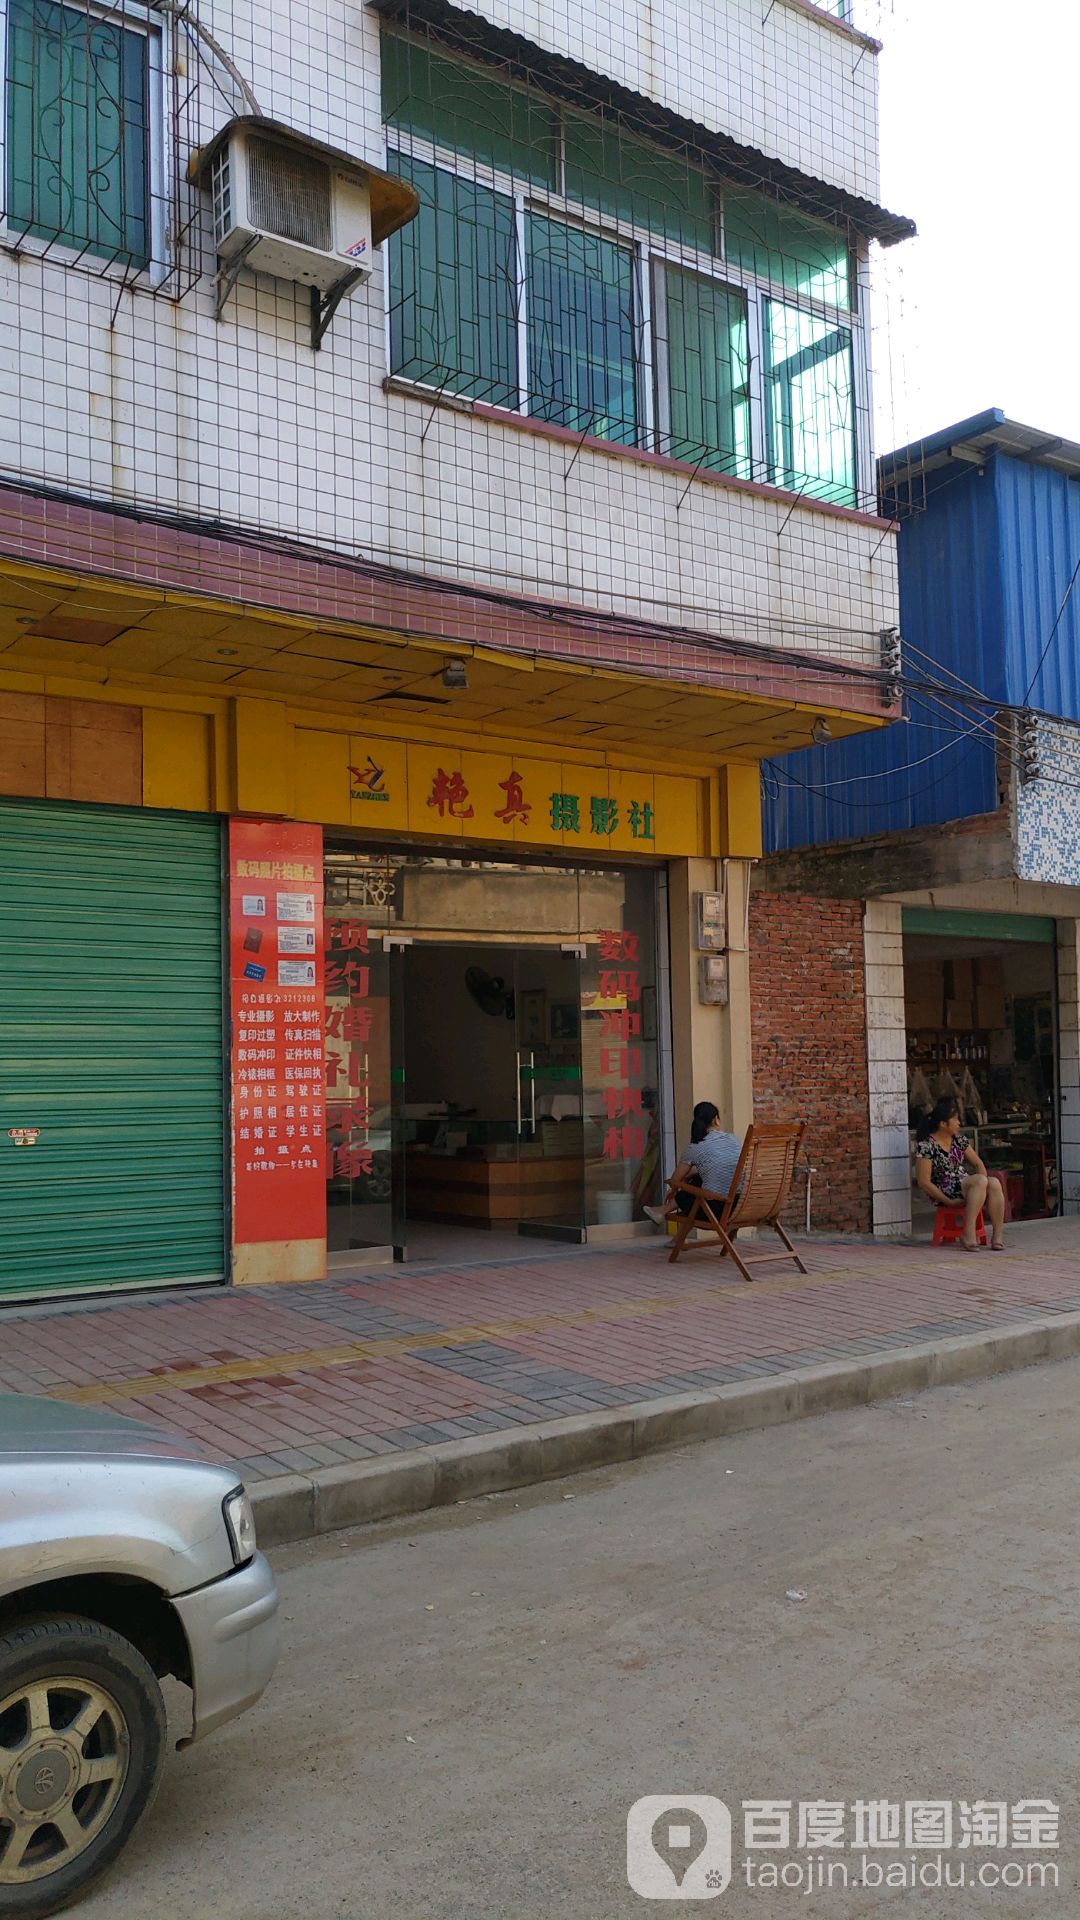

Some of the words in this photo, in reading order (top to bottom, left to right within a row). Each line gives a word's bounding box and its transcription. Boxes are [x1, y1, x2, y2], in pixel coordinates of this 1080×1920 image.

[427, 767, 656, 840] 艳真摄影社
[237, 1010, 275, 1022] 专业摄影
[284, 1010, 320, 1022] 放大制作
[239, 1029, 276, 1041] 复印过塑
[285, 1028, 321, 1040] 传真扫描
[323, 917, 375, 1180] 预约婚礼录像
[597, 929, 646, 1161] 数码冲印快相
[238, 1048, 276, 1061] 数码冲印
[285, 1048, 322, 1060] 证件快相
[285, 1067, 322, 1079] 医保回执
[240, 1085, 276, 1099] 身份证
[286, 1084, 321, 1097] 驾驶证
[240, 1106, 276, 1119] 护照相
[286, 1104, 321, 1118] 居住证
[240, 1126, 277, 1139] 结婚证
[286, 1124, 321, 1137] 学生证
